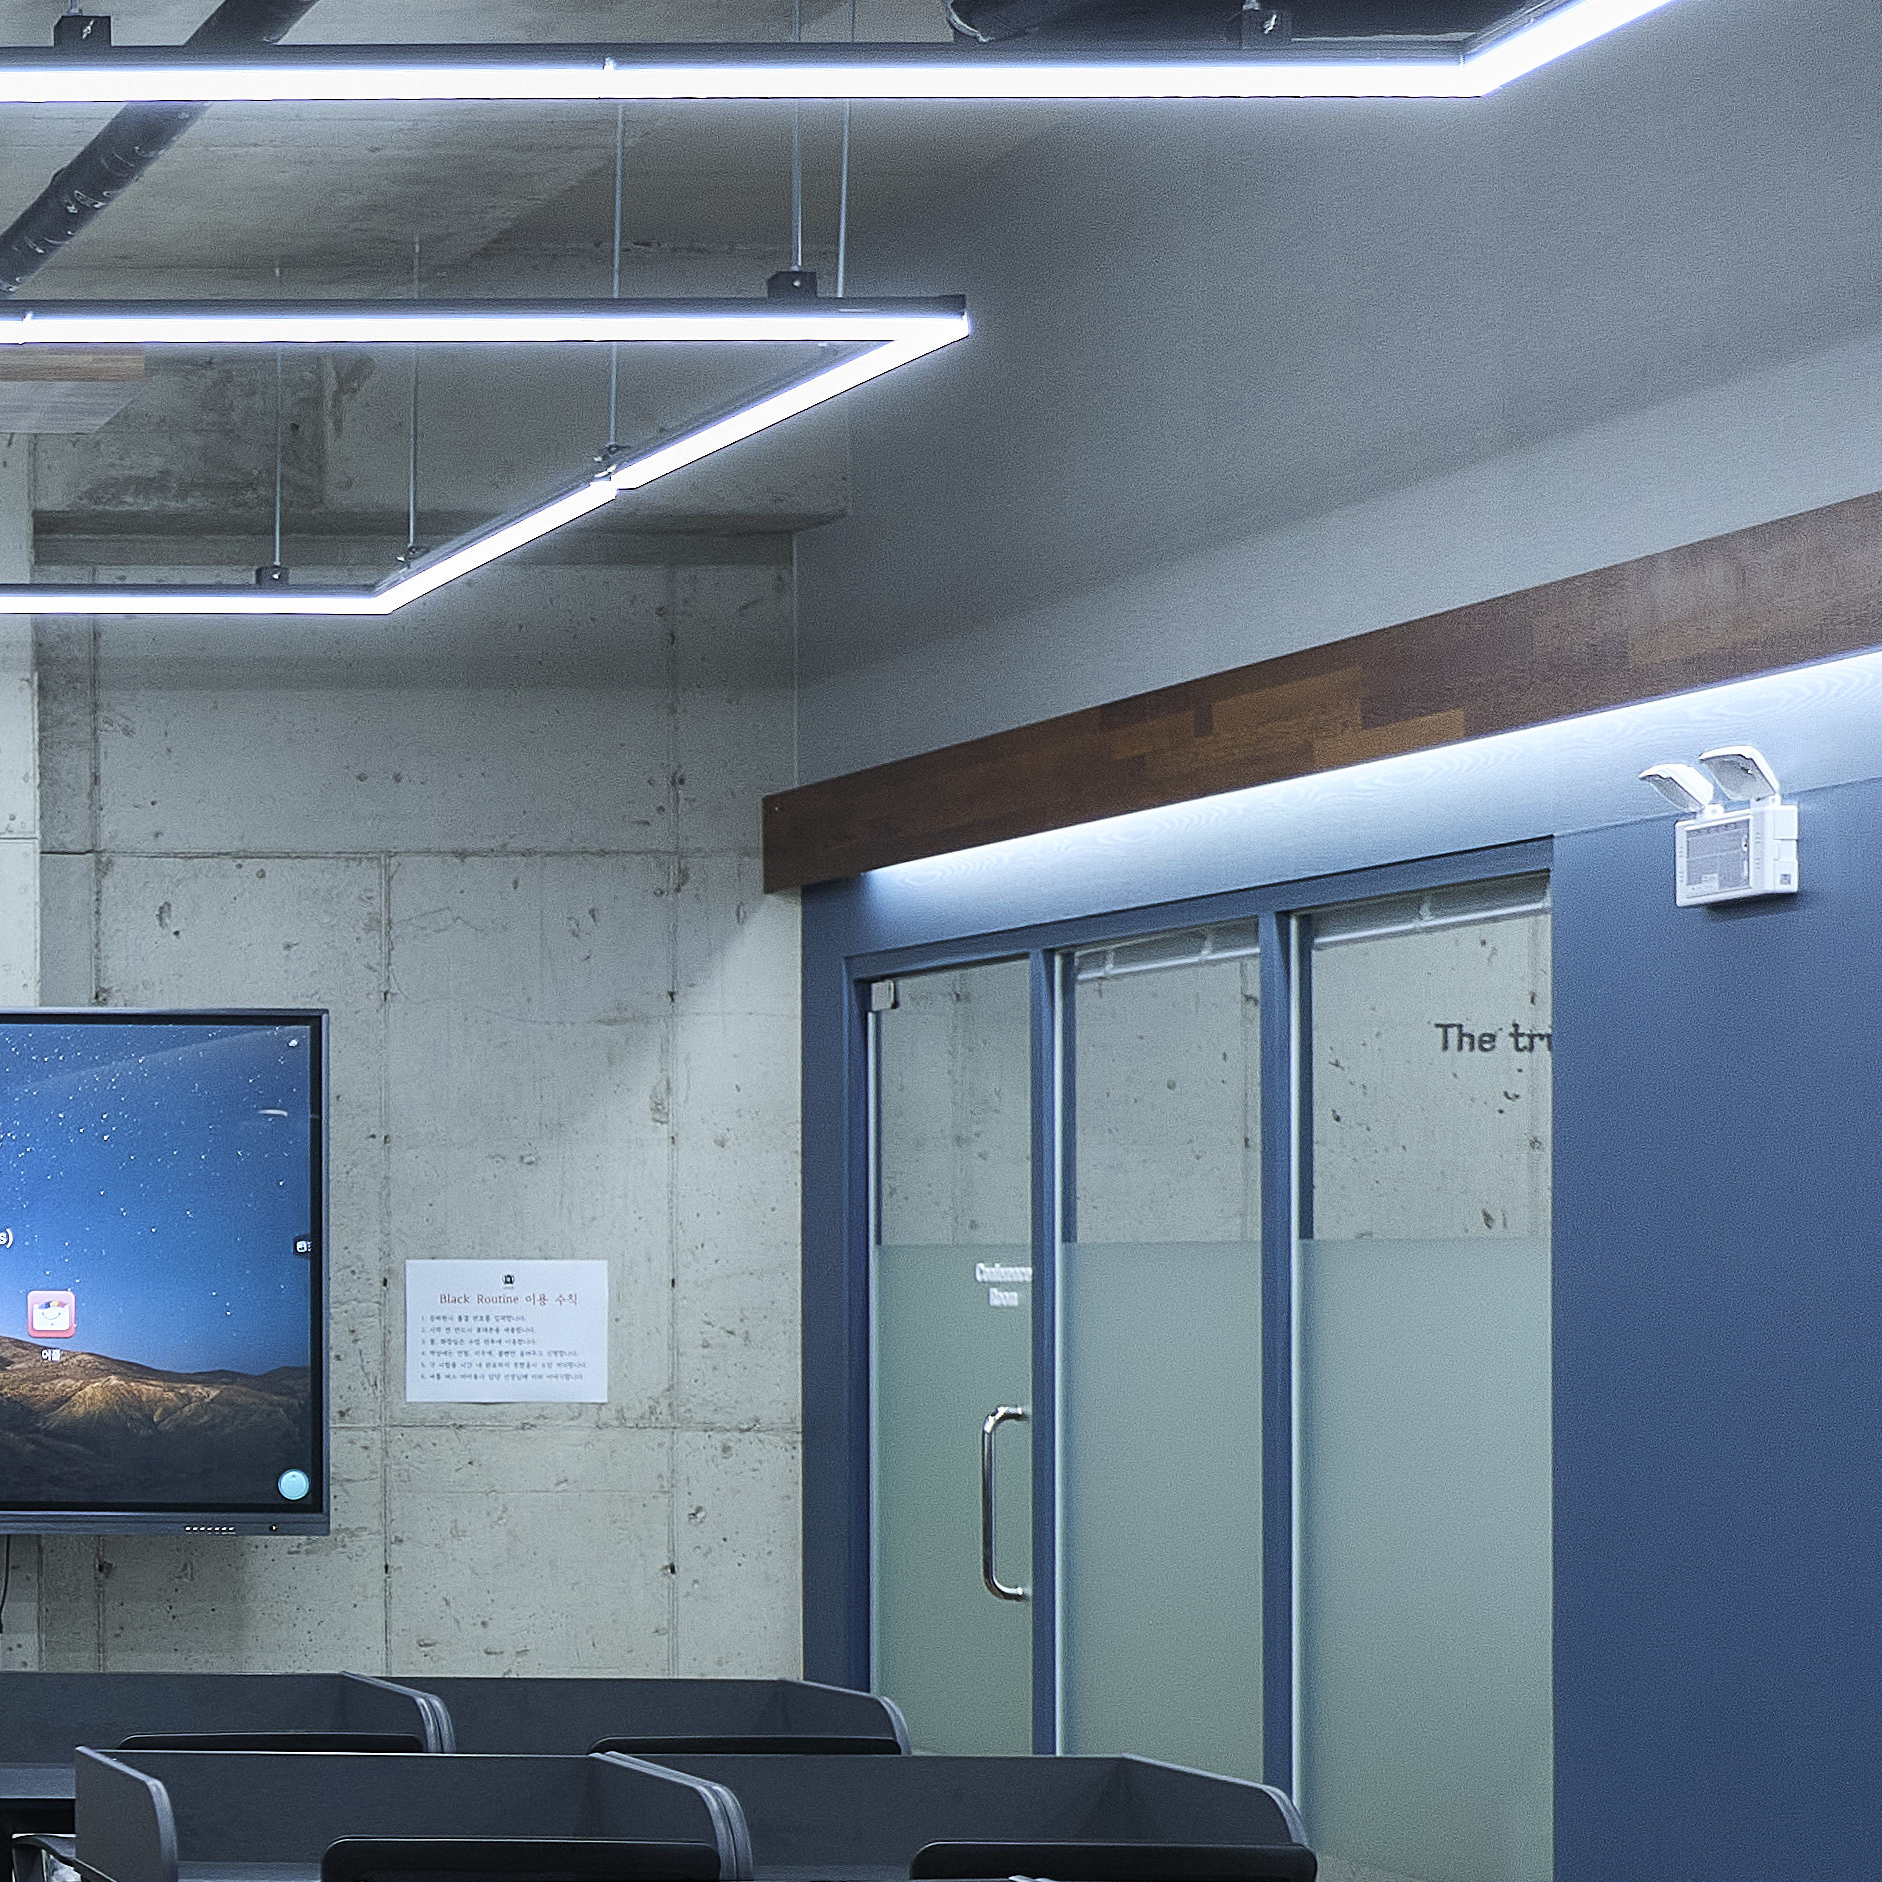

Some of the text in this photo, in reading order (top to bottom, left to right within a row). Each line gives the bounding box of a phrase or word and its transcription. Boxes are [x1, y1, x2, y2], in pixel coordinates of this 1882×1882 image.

[1434, 1022, 1497, 1052] The
[439, 1293, 471, 1305] Black
[476, 1293, 519, 1305] Routine
[524, 1292, 549, 1307] 이용
